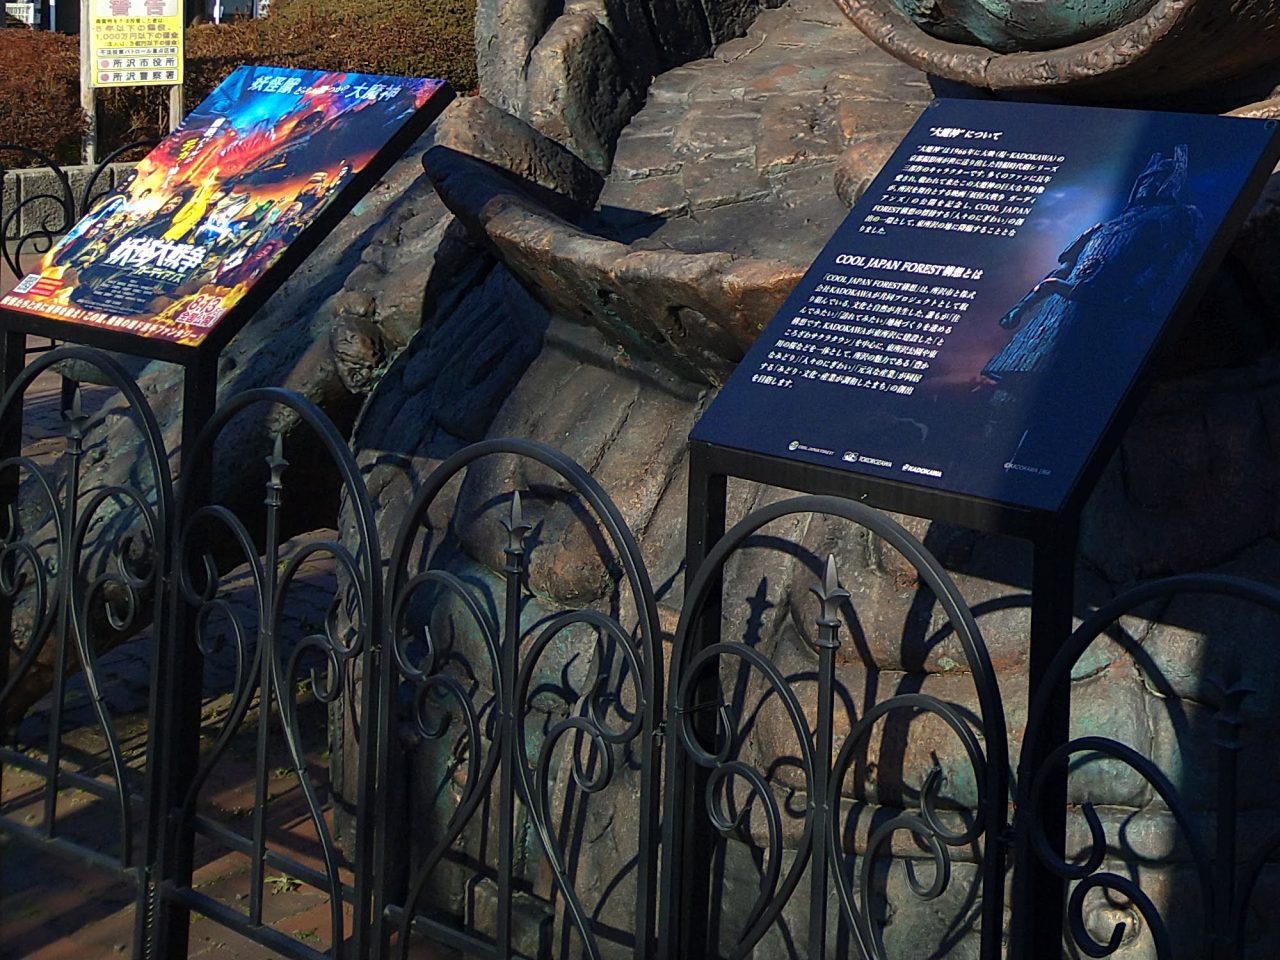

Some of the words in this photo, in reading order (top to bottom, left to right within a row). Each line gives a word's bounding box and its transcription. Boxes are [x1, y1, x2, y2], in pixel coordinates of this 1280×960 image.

[113, 59, 175, 68] 所沢市役所
[113, 71, 175, 82] 所沢警察署
[345, 82, 402, 101] 大魔神
[1000, 205, 1031, 214] JAPAN
[859, 225, 887, 234] りました。
[104, 237, 206, 272] 妖怪大戦争
[835, 254, 865, 266] COOL
[863, 257, 902, 270] JAPAN
[899, 261, 983, 279] FOREST構想とは
[846, 276, 872, 285] JAPAN
[189, 295, 221, 313] 8.13
[751, 373, 792, 387] を目指します。
[858, 455, 893, 468] TOKOROZAWA
[908, 466, 942, 478] KADOKAWA
